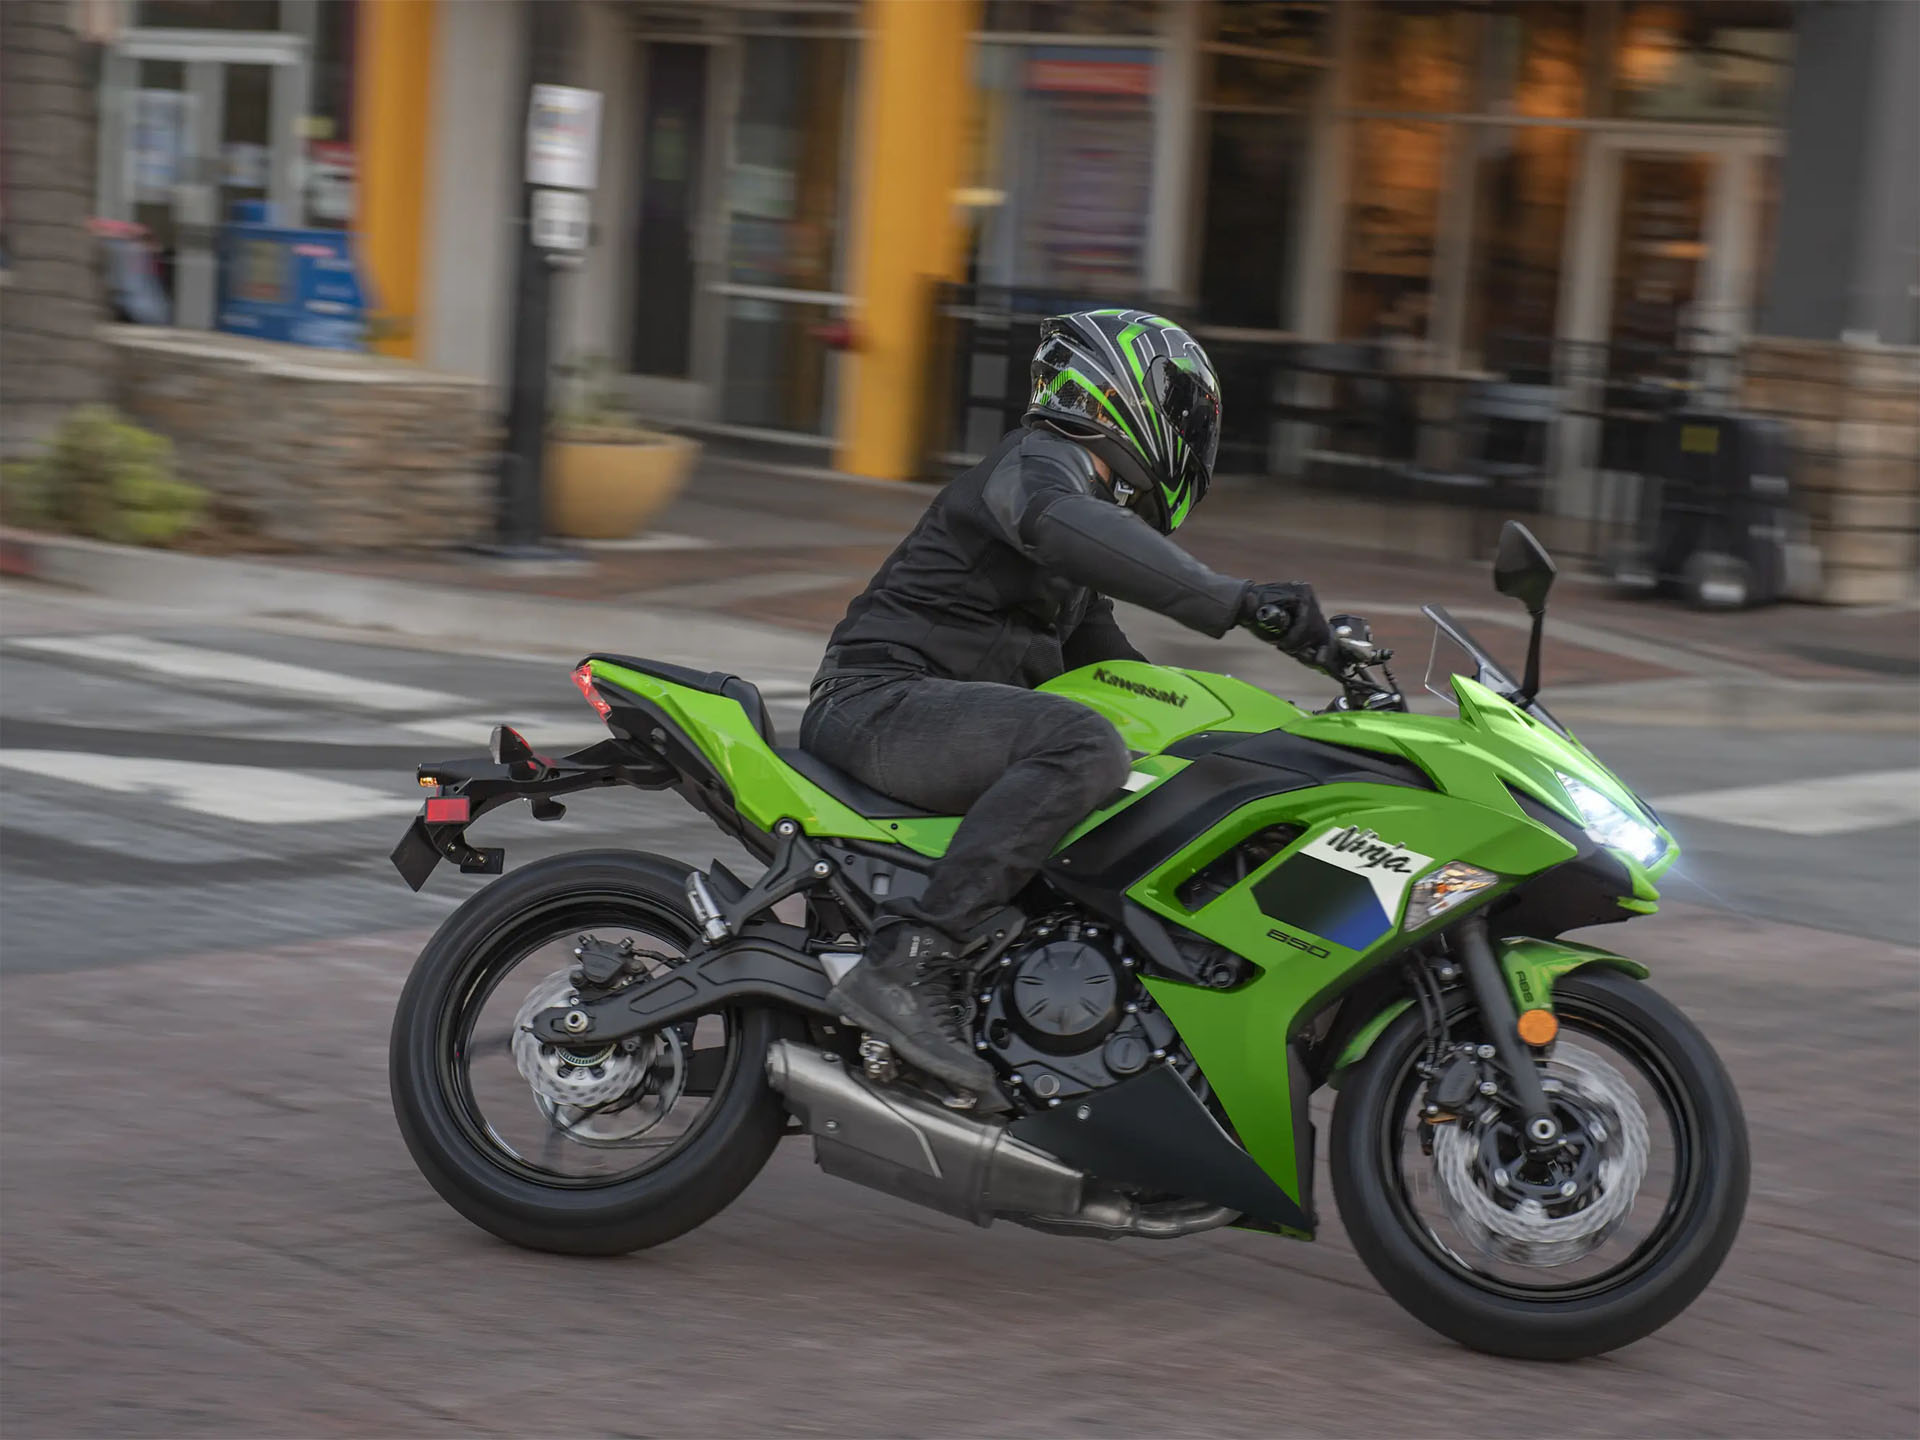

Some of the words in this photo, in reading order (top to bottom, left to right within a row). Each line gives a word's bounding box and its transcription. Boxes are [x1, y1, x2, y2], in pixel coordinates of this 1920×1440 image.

[1092, 667, 1188, 709] Kawasaki
[1326, 825, 1412, 873] Ninja
[1266, 929, 1331, 959] 650
[1515, 970, 1534, 1003] ABS
